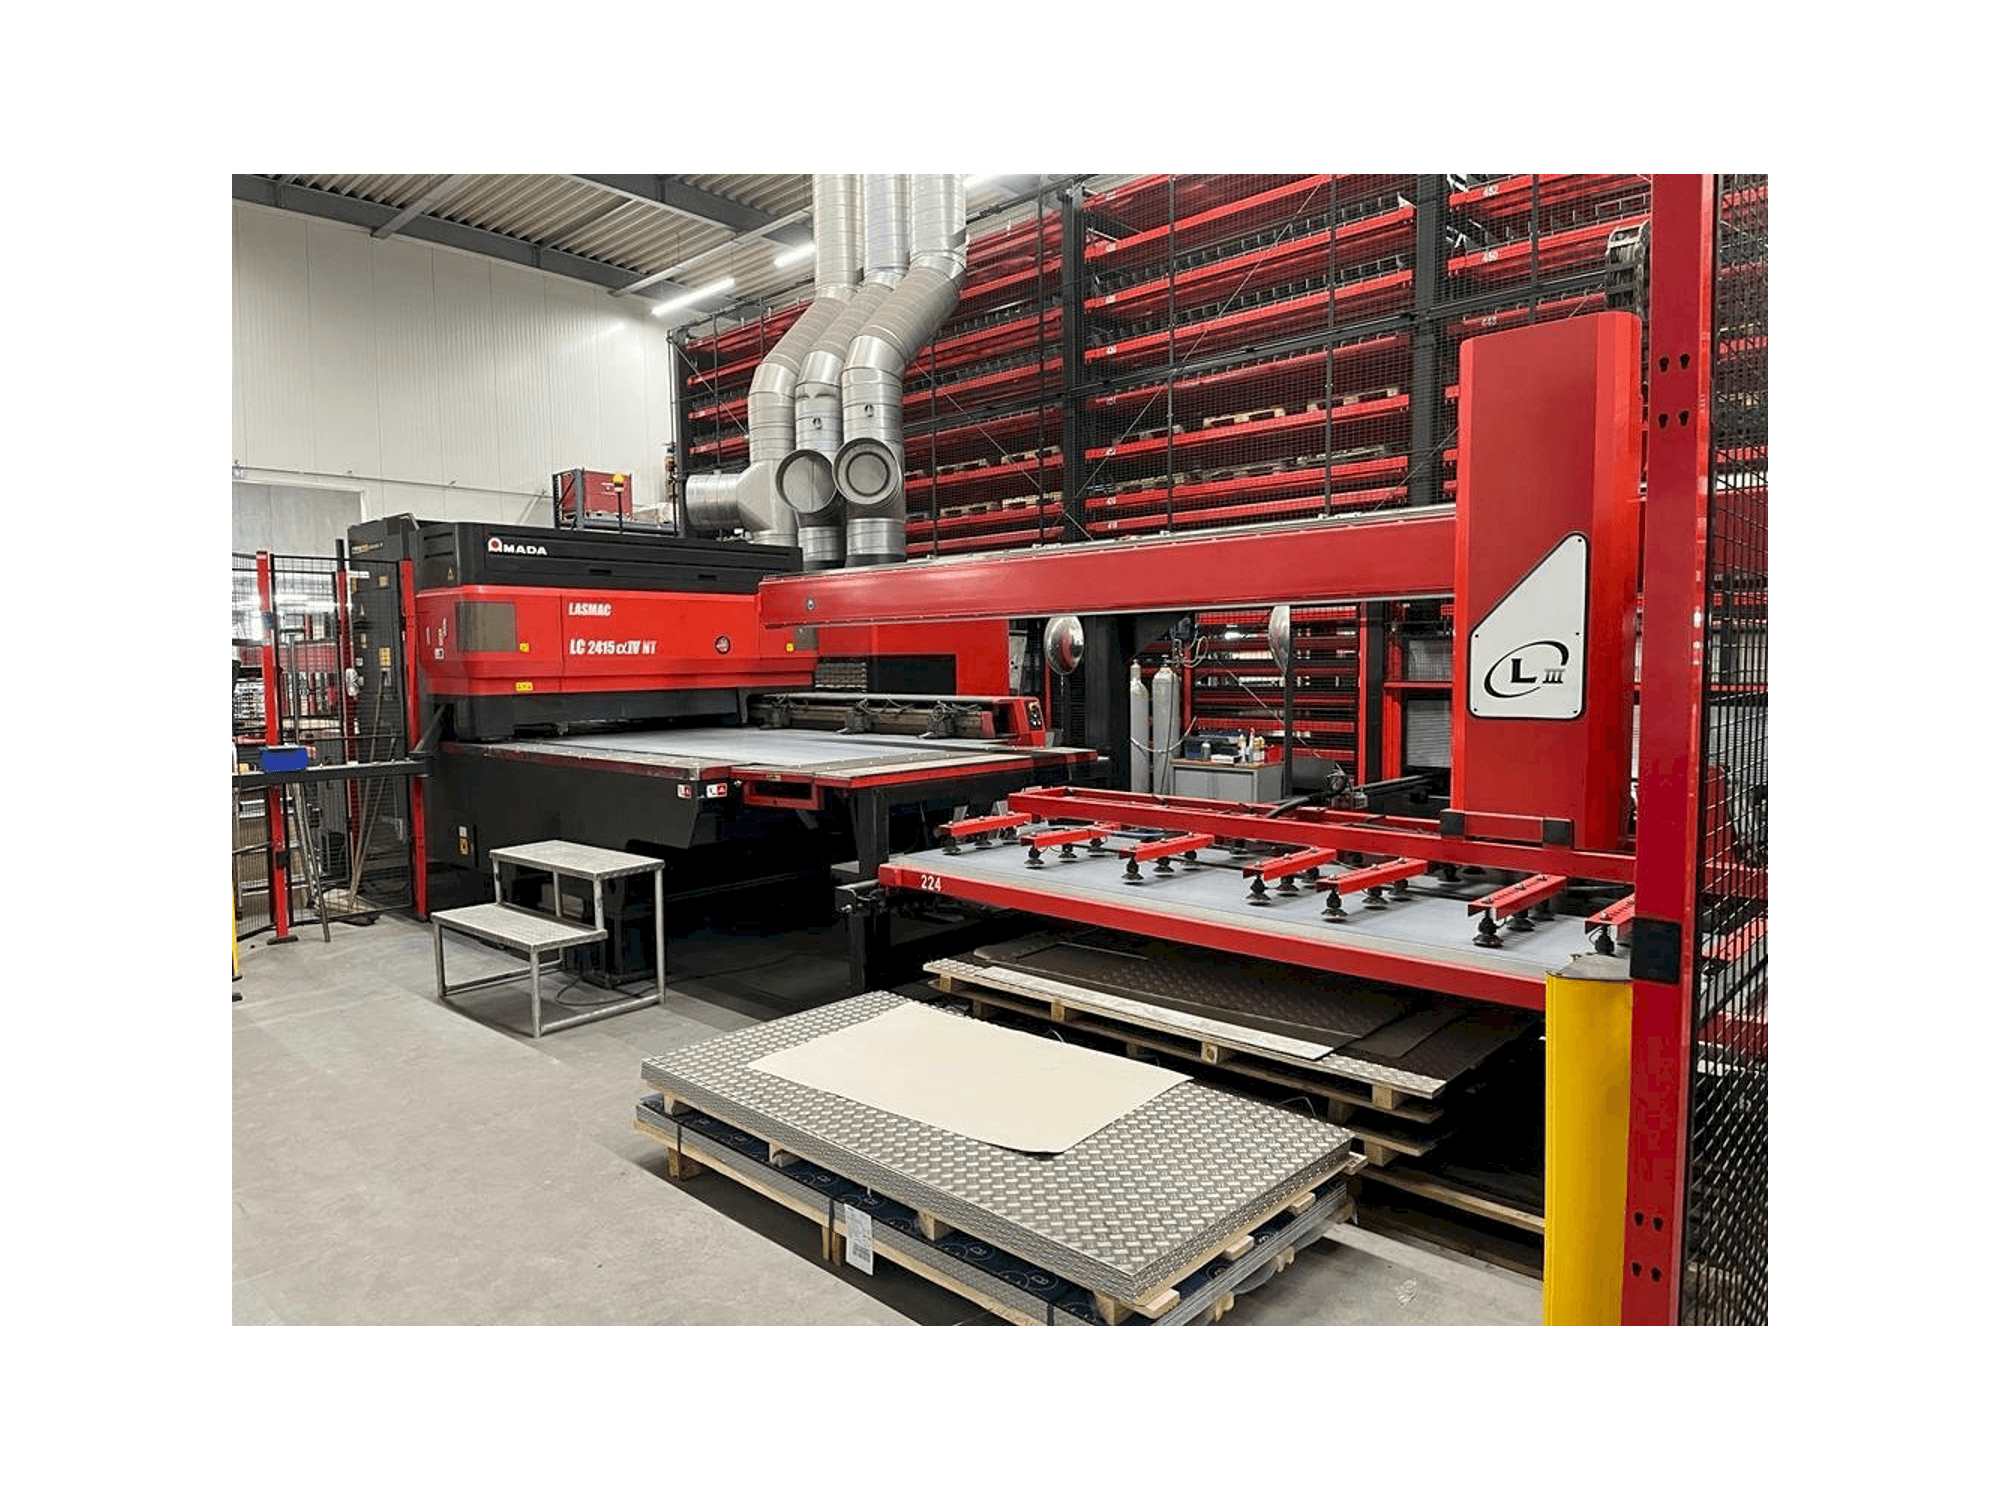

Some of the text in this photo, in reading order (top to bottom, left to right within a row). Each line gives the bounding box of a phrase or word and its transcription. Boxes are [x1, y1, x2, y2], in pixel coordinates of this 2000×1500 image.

[488, 537, 548, 555] AMADA
[568, 602, 612, 616] LASMAC
[569, 639, 586, 655] LC
[1510, 658, 1538, 683] L
